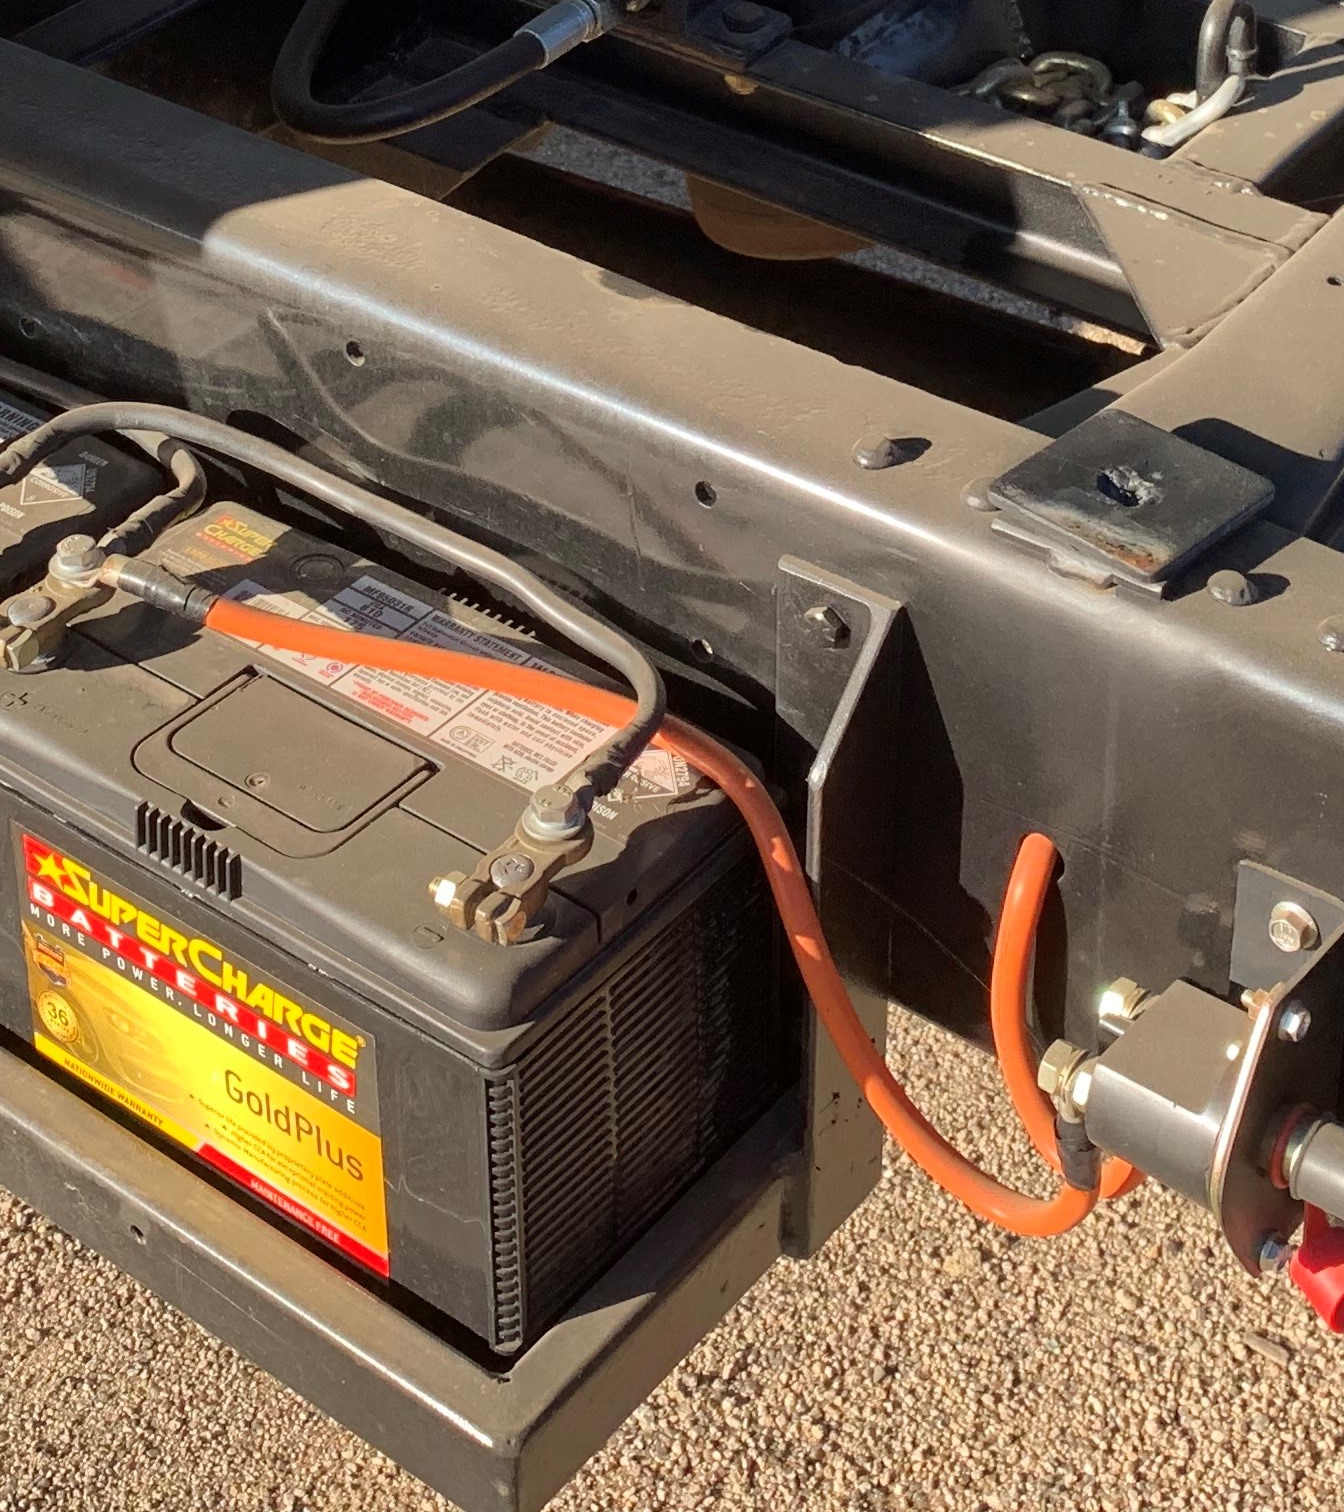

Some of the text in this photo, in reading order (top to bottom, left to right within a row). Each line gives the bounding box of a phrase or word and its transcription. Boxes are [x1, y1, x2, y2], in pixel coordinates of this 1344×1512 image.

[431, 613, 477, 639] WARRANTY
[474, 634, 524, 663] STATEMENT
[673, 753, 691, 787] UN2794
[29, 902, 85, 947] MORE
[194, 1003, 283, 1070] LONGER
[302, 1069, 356, 1115] LIFE
[31, 880, 350, 1093] BATTERIES
[46, 999, 68, 1028] 36
[64, 1056, 164, 1129] NATIONWIDE WARRANTY
[224, 1066, 363, 1184] GoldPlus
[250, 1177, 339, 1244] MAINTENANCE FREE
